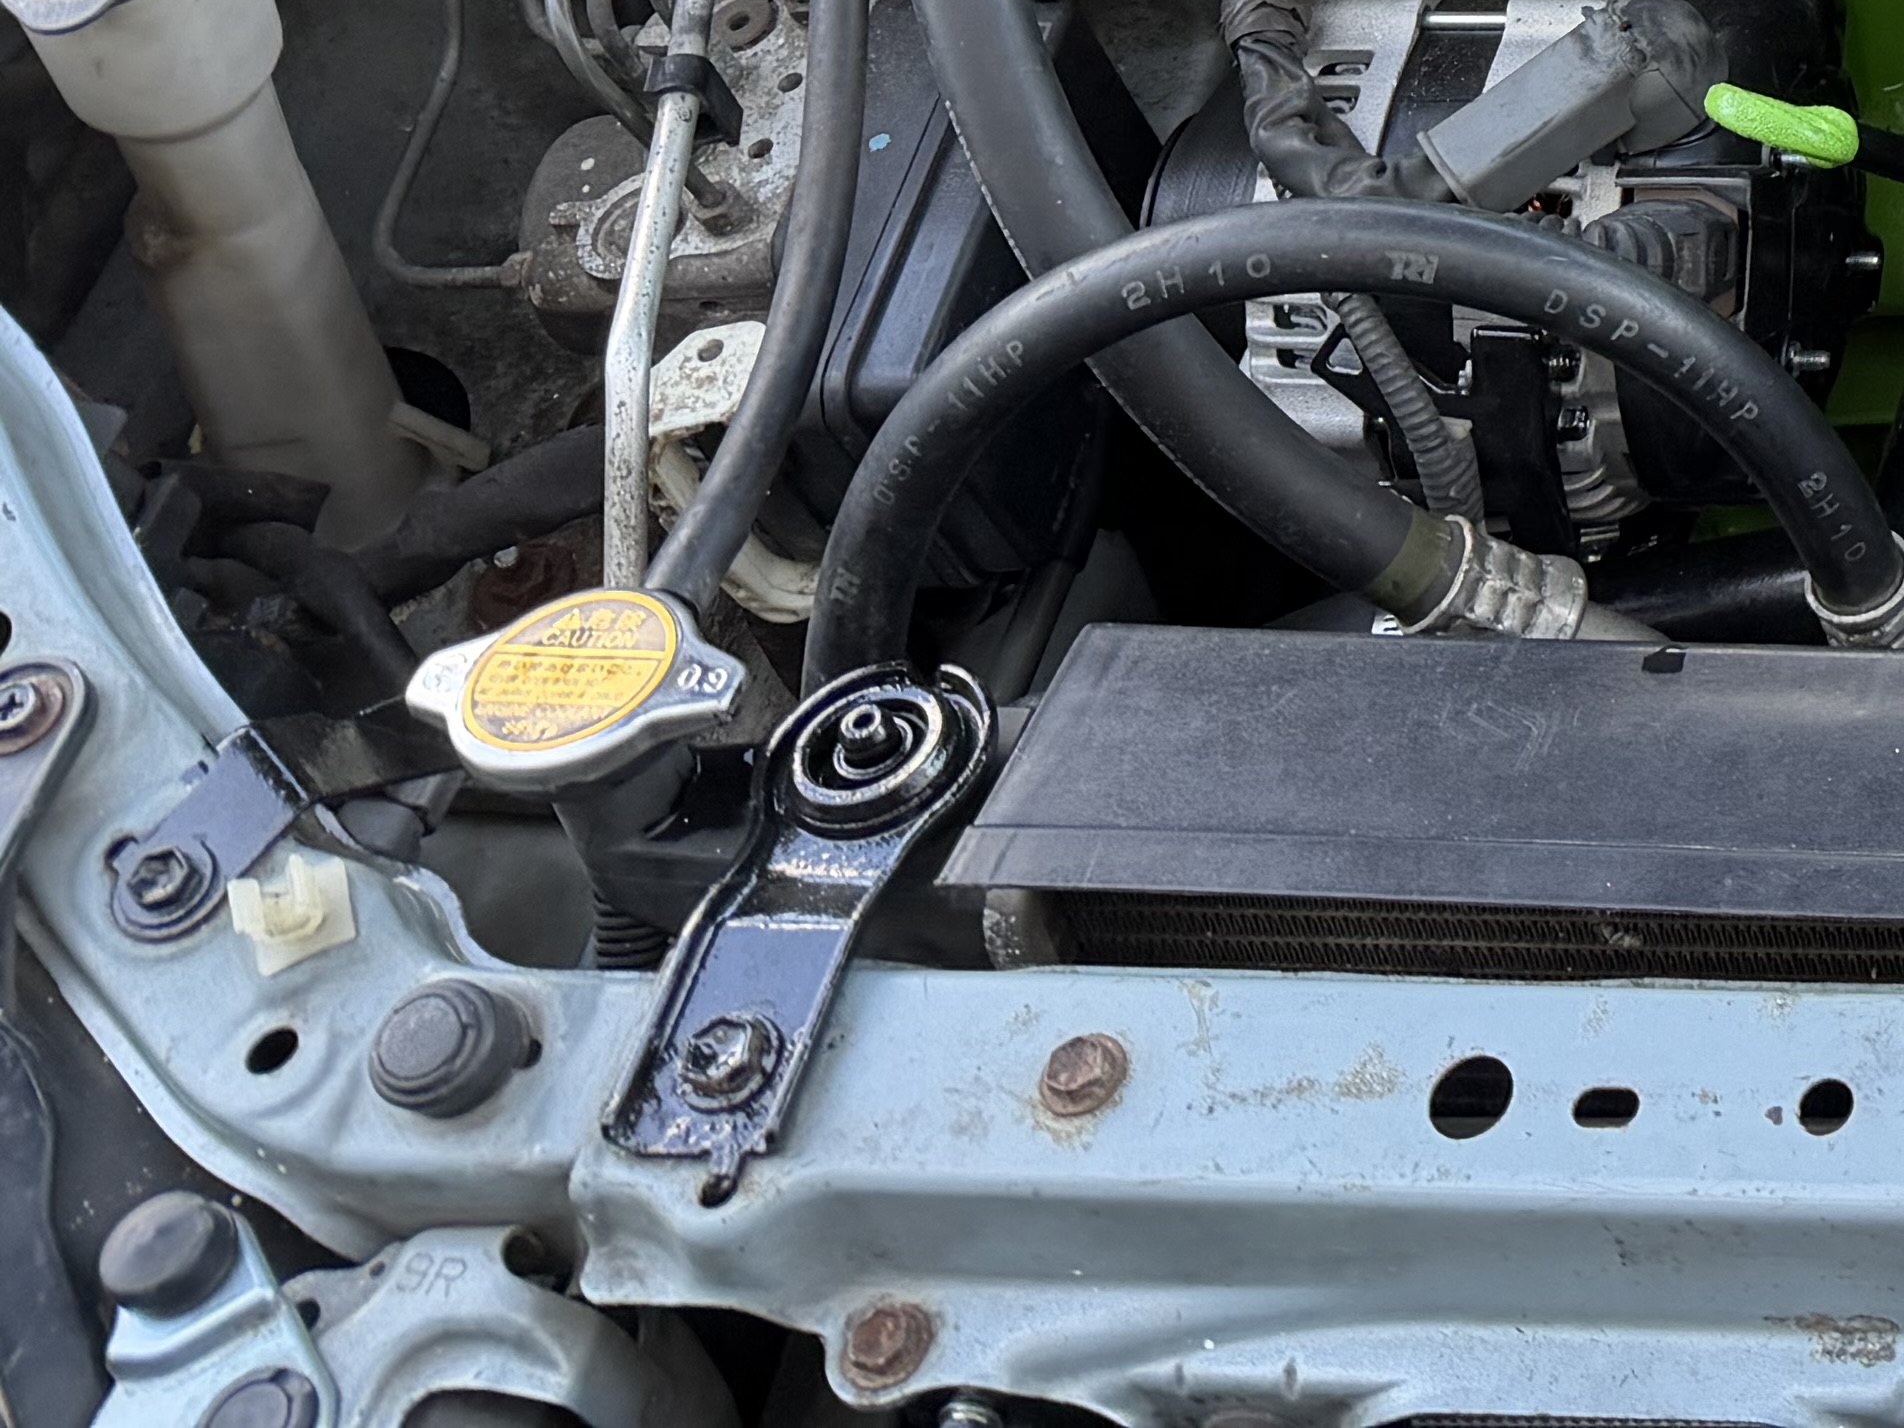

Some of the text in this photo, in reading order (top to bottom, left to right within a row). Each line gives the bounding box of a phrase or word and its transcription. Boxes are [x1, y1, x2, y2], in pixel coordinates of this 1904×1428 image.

[541, 628, 640, 648] CAUTION
[677, 663, 729, 693] 0.9
[395, 1252, 468, 1299] 9R
